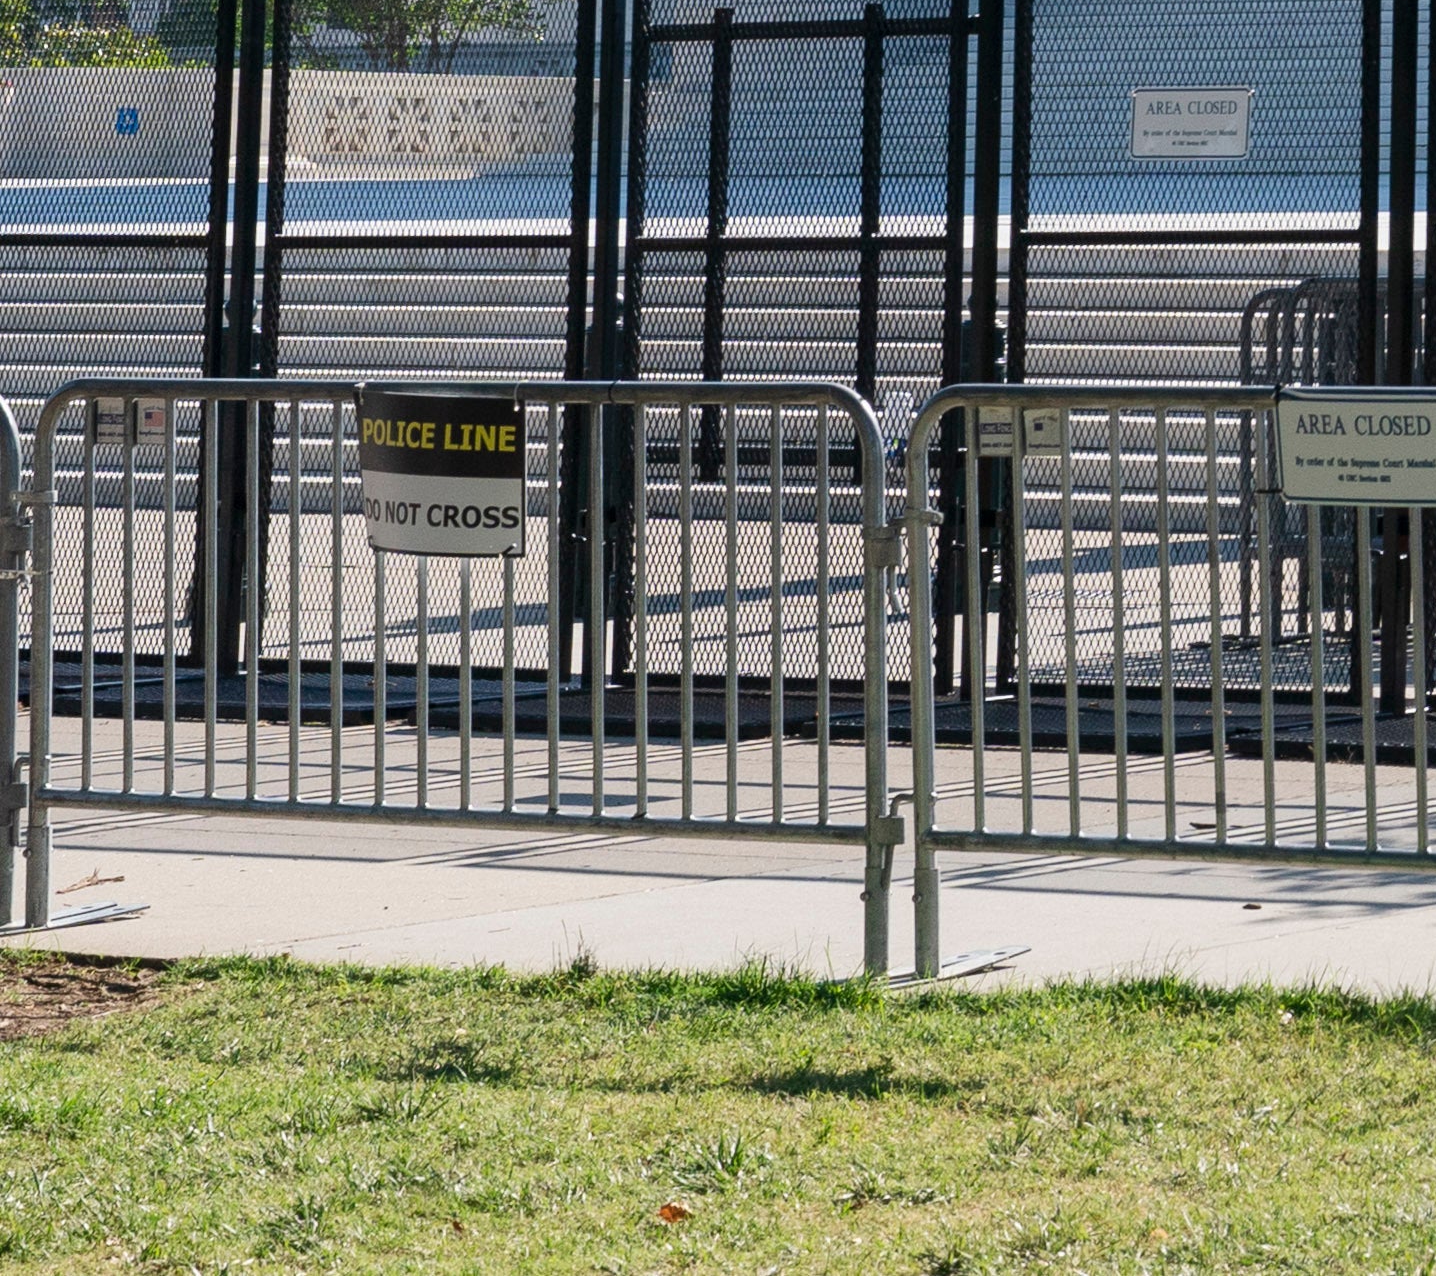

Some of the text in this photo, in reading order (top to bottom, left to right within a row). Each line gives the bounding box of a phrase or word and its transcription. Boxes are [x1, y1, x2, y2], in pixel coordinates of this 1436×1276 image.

[1145, 100, 1238, 116] AREA CLOSED
[362, 418, 517, 453] POLICE LINE
[1295, 413, 1432, 437] AREA CLOSED
[1382, 458, 1404, 469] Court
[365, 497, 520, 530] DO NOT CROSS
